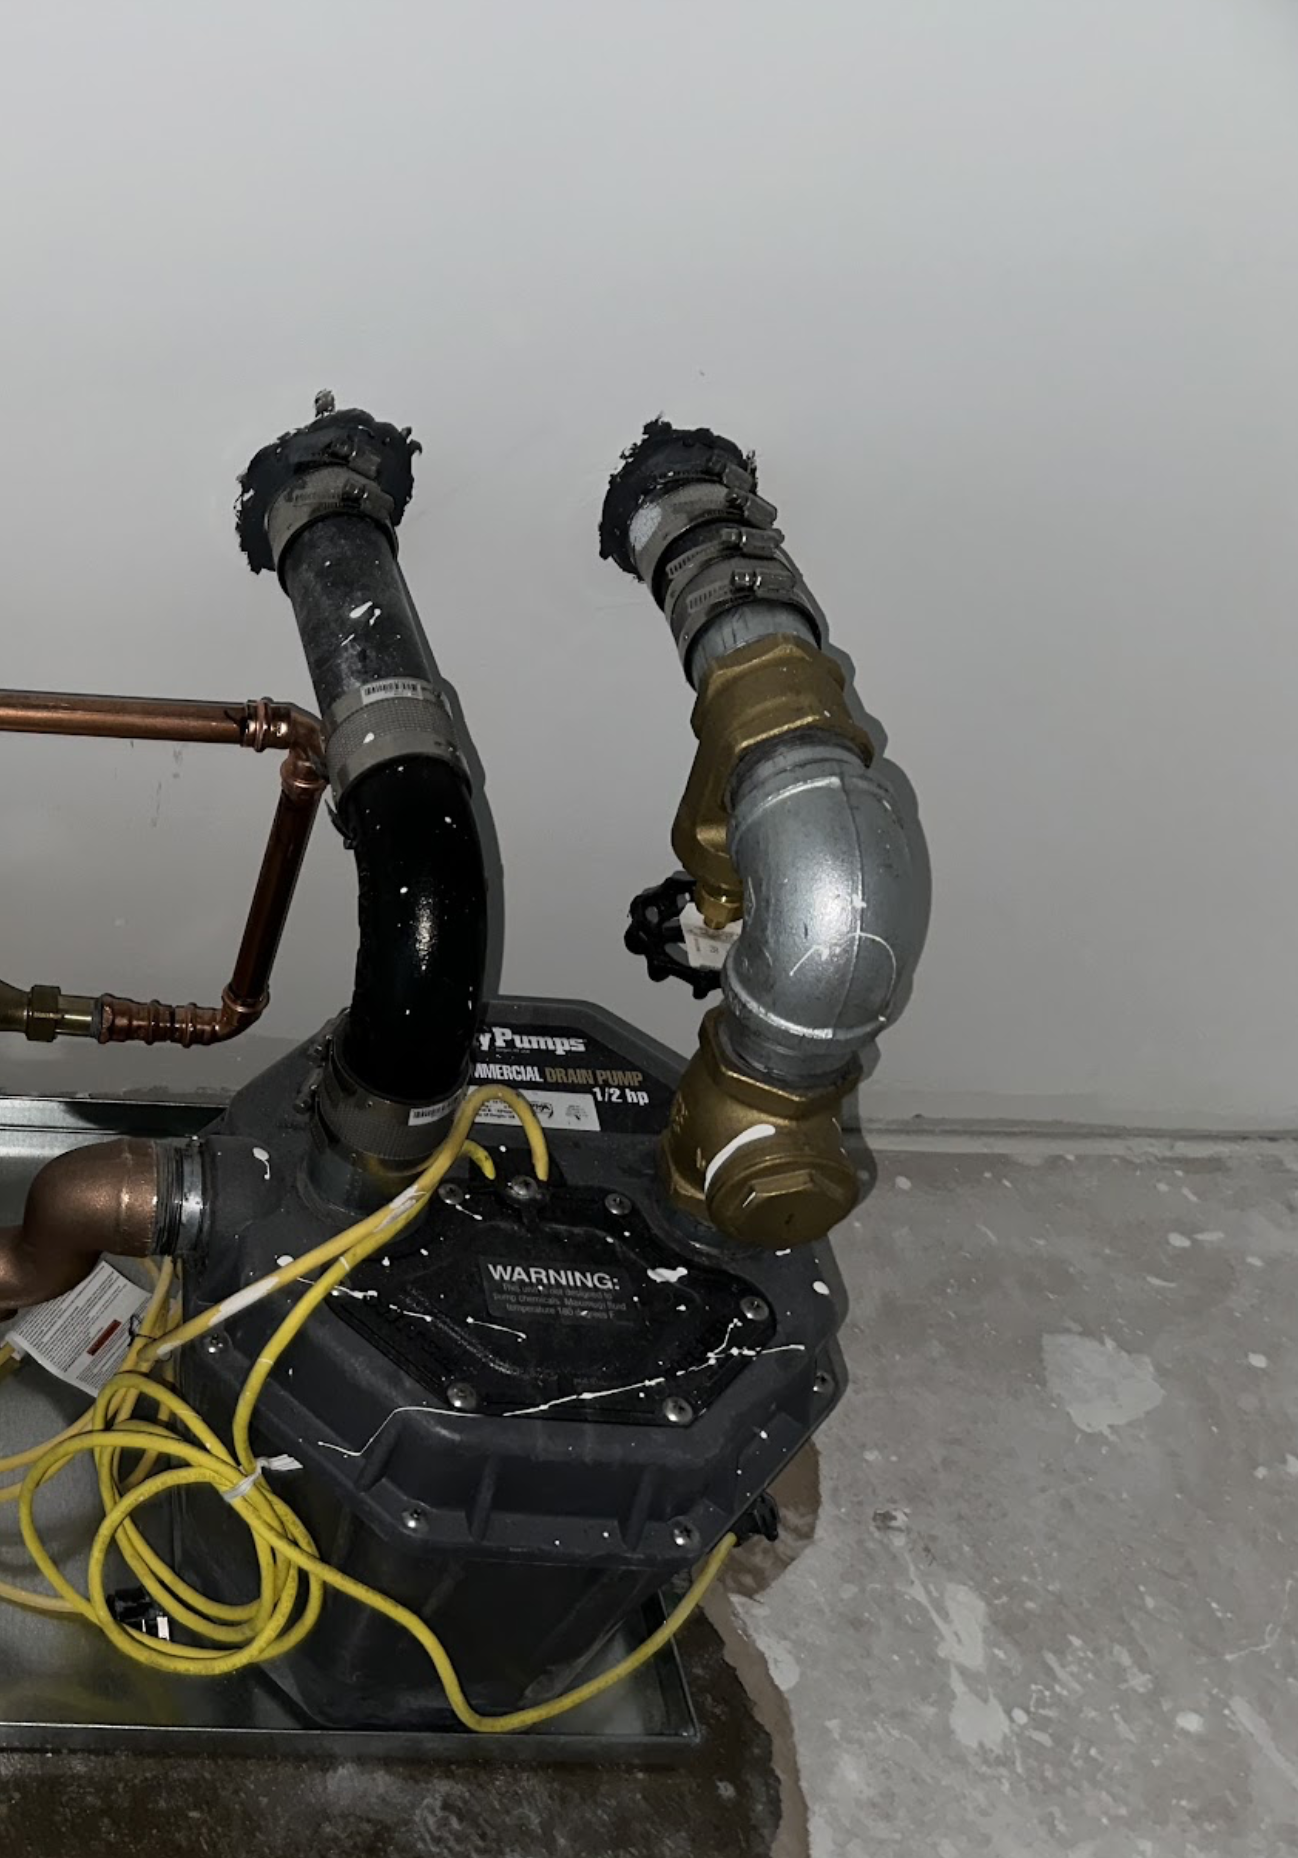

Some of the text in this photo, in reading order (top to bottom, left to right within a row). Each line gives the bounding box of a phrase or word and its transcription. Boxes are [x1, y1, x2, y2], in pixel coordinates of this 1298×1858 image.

[492, 1026, 586, 1055] Pumps
[474, 1062, 643, 1086] MMERCIAL DRAIN PUMP
[592, 1087, 649, 1106] 1/2 hp
[487, 1263, 620, 1290] WARNING:
[575, 1308, 607, 1319] dgrees
